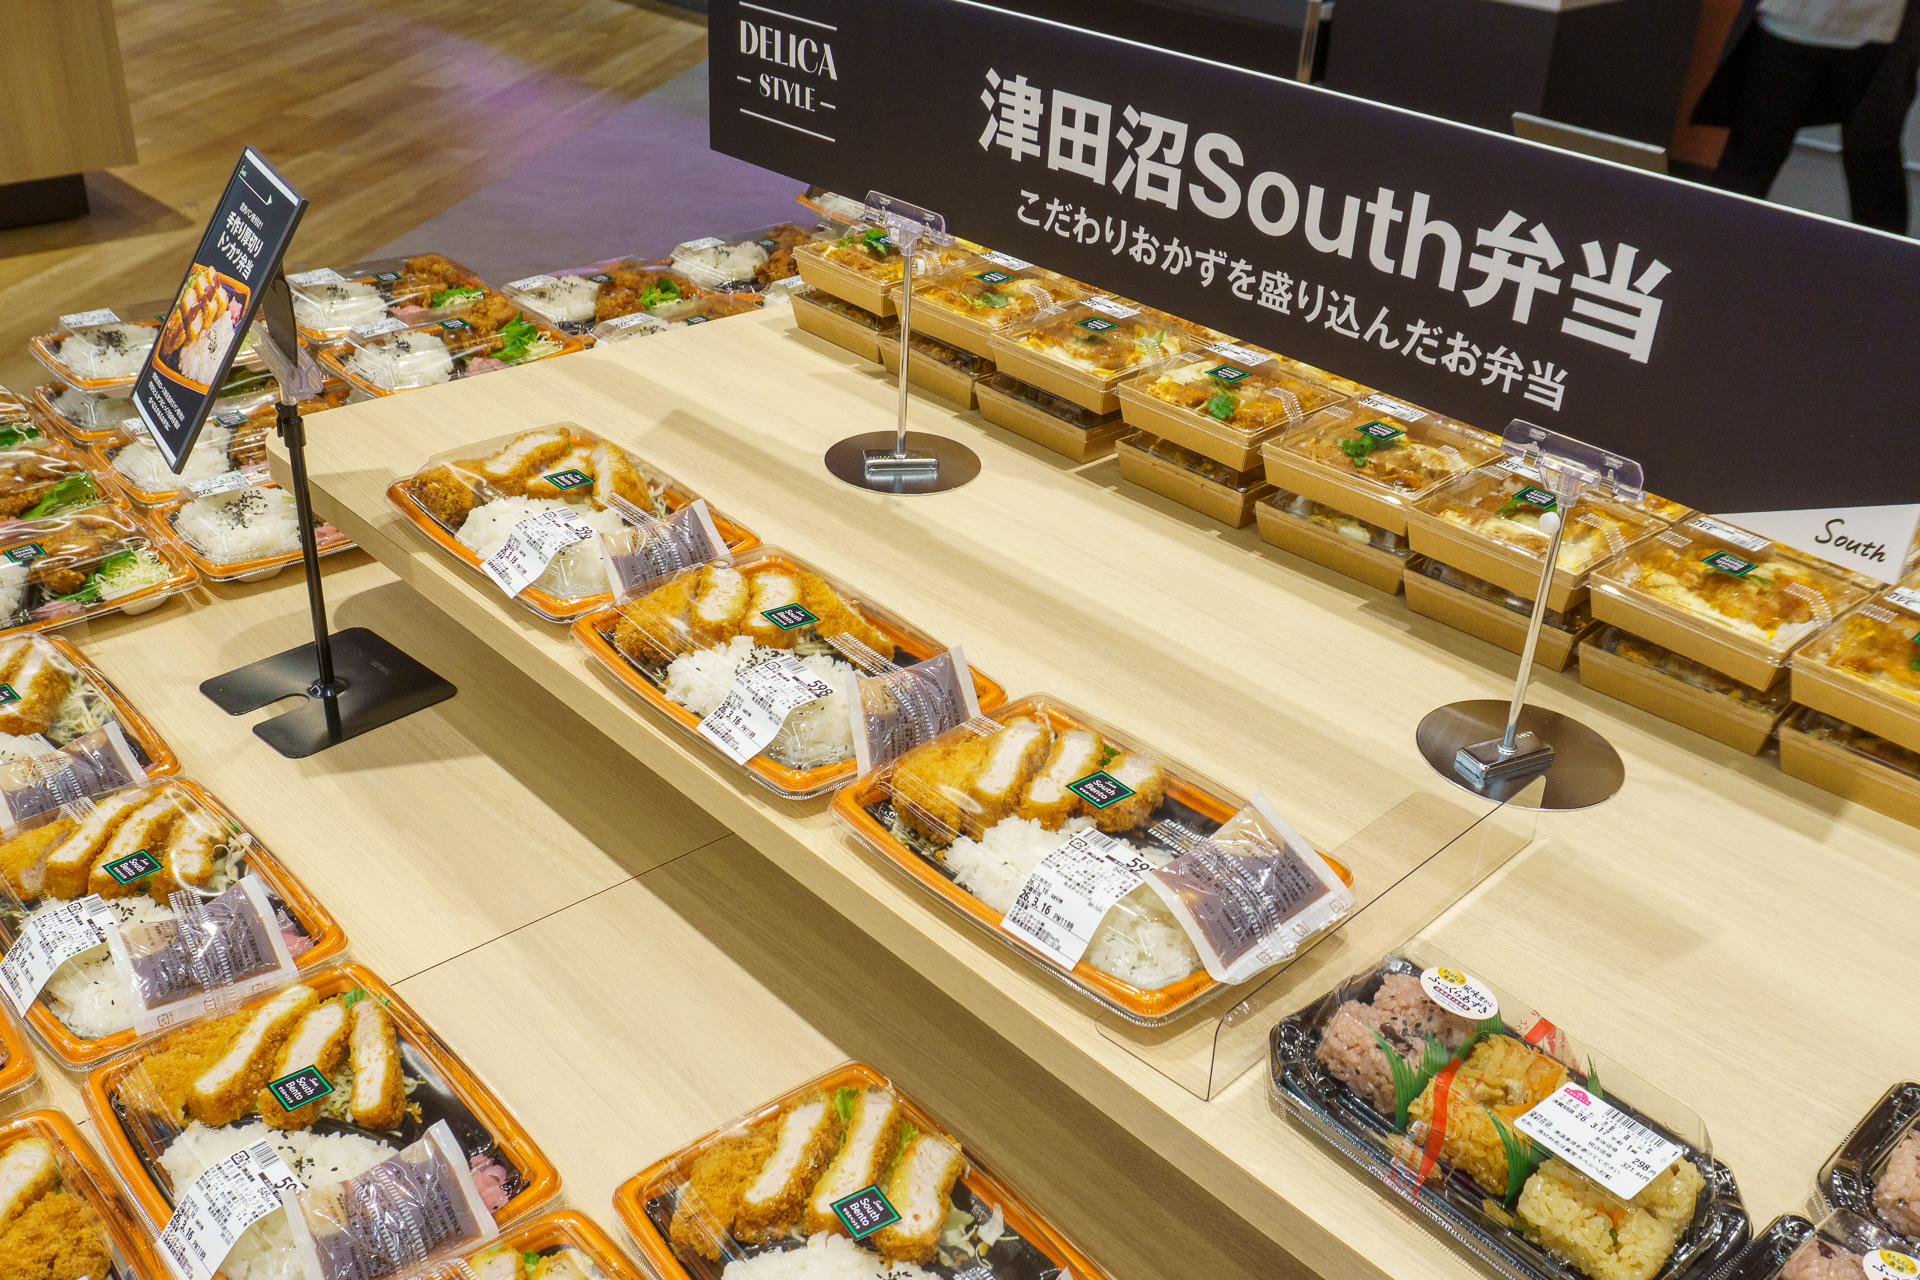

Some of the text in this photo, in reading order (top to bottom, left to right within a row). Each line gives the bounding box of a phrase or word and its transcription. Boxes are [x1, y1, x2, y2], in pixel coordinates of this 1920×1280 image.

[739, 19, 838, 81] DELICA
[759, 73, 815, 112] STYLE
[978, 67, 1672, 364] 津田沼South弁当
[226, 211, 264, 258] 手作り厚切り
[217, 230, 254, 280] トンカツ弁当
[1017, 188, 1569, 412] こだわりおかずを盛り込んだお弁当
[1814, 518, 1887, 563] South
[806, 677, 835, 699] 598
[1084, 783, 1108, 800] Bento
[1092, 779, 1116, 796] South
[1015, 888, 1055, 915] 26.3.16
[285, 1081, 303, 1100] Bento
[296, 1076, 315, 1096] South
[849, 1202, 869, 1226] Bento
[860, 1198, 880, 1221] South
[172, 1209, 195, 1241] 26.3.16
